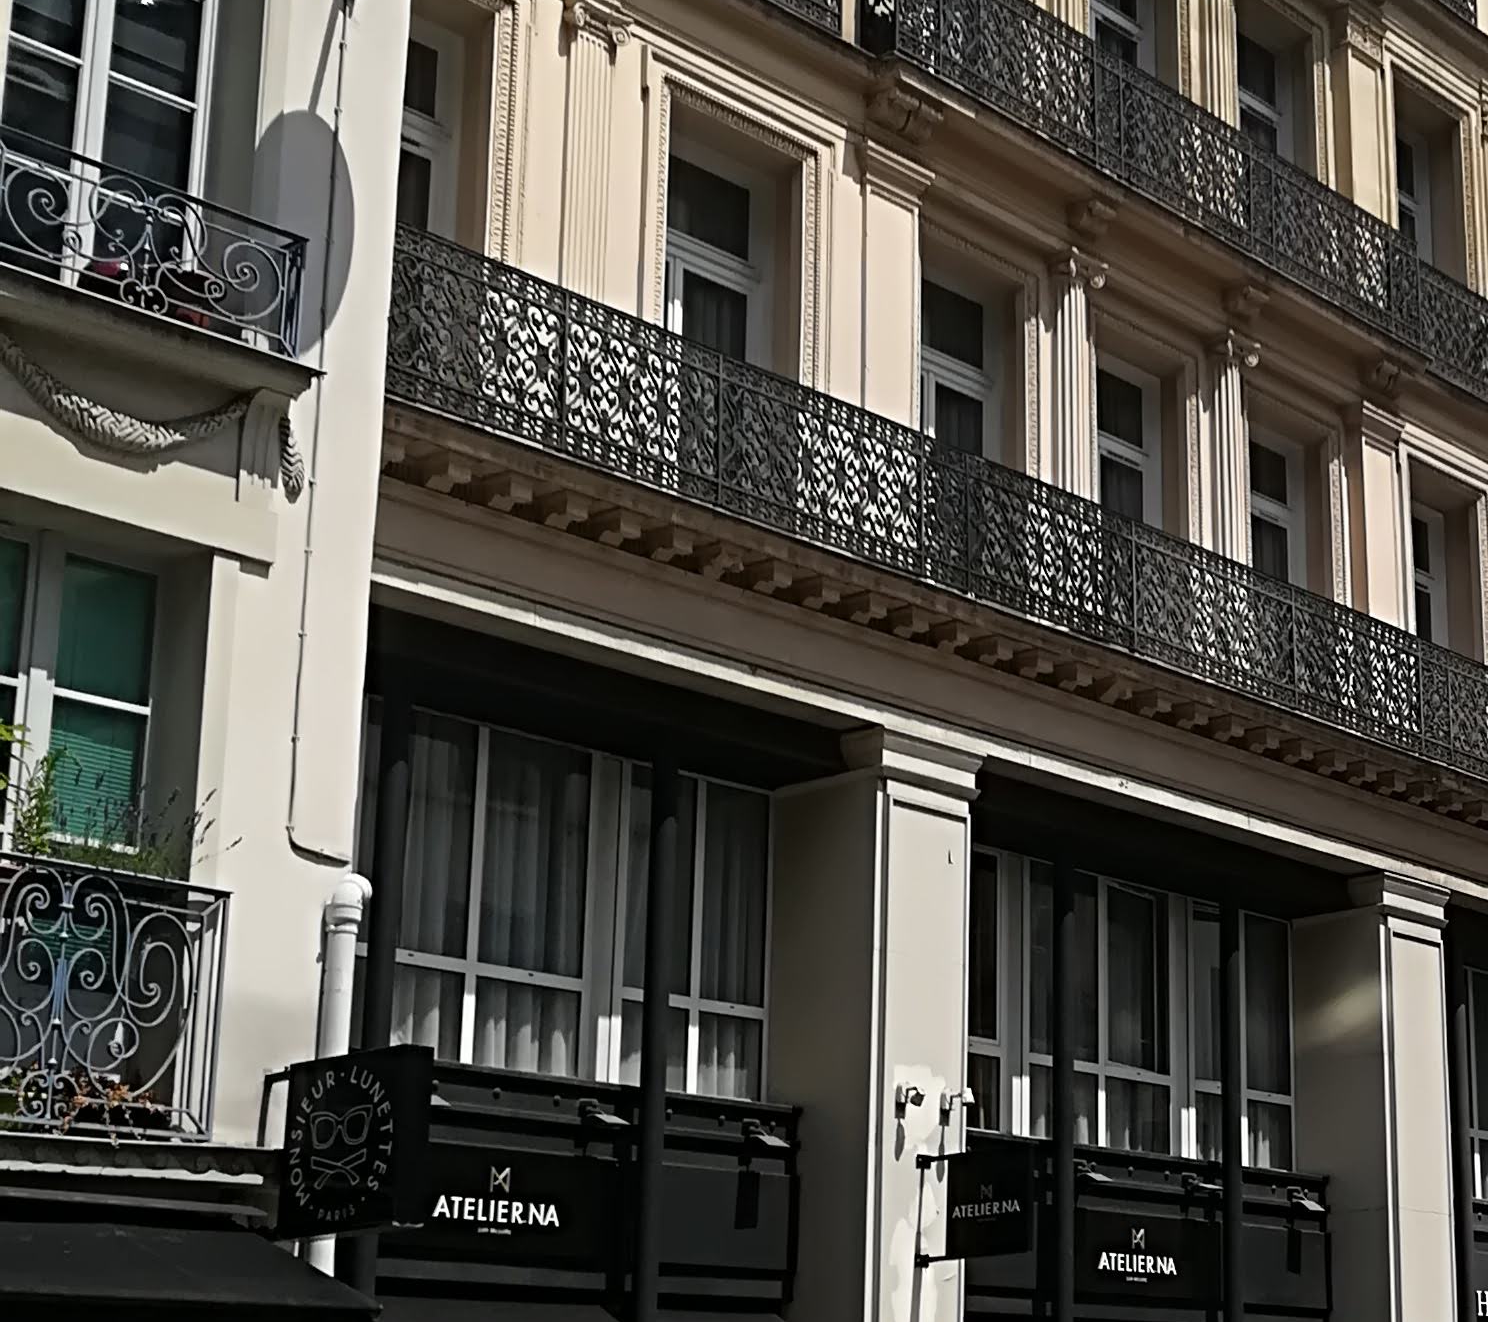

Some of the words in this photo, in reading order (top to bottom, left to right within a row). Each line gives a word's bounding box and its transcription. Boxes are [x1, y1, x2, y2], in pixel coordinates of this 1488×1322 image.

[289, 1070, 336, 1206] MONSIEUR
[350, 1065, 394, 1191] LUNETTES
[317, 1204, 356, 1221] PARIS
